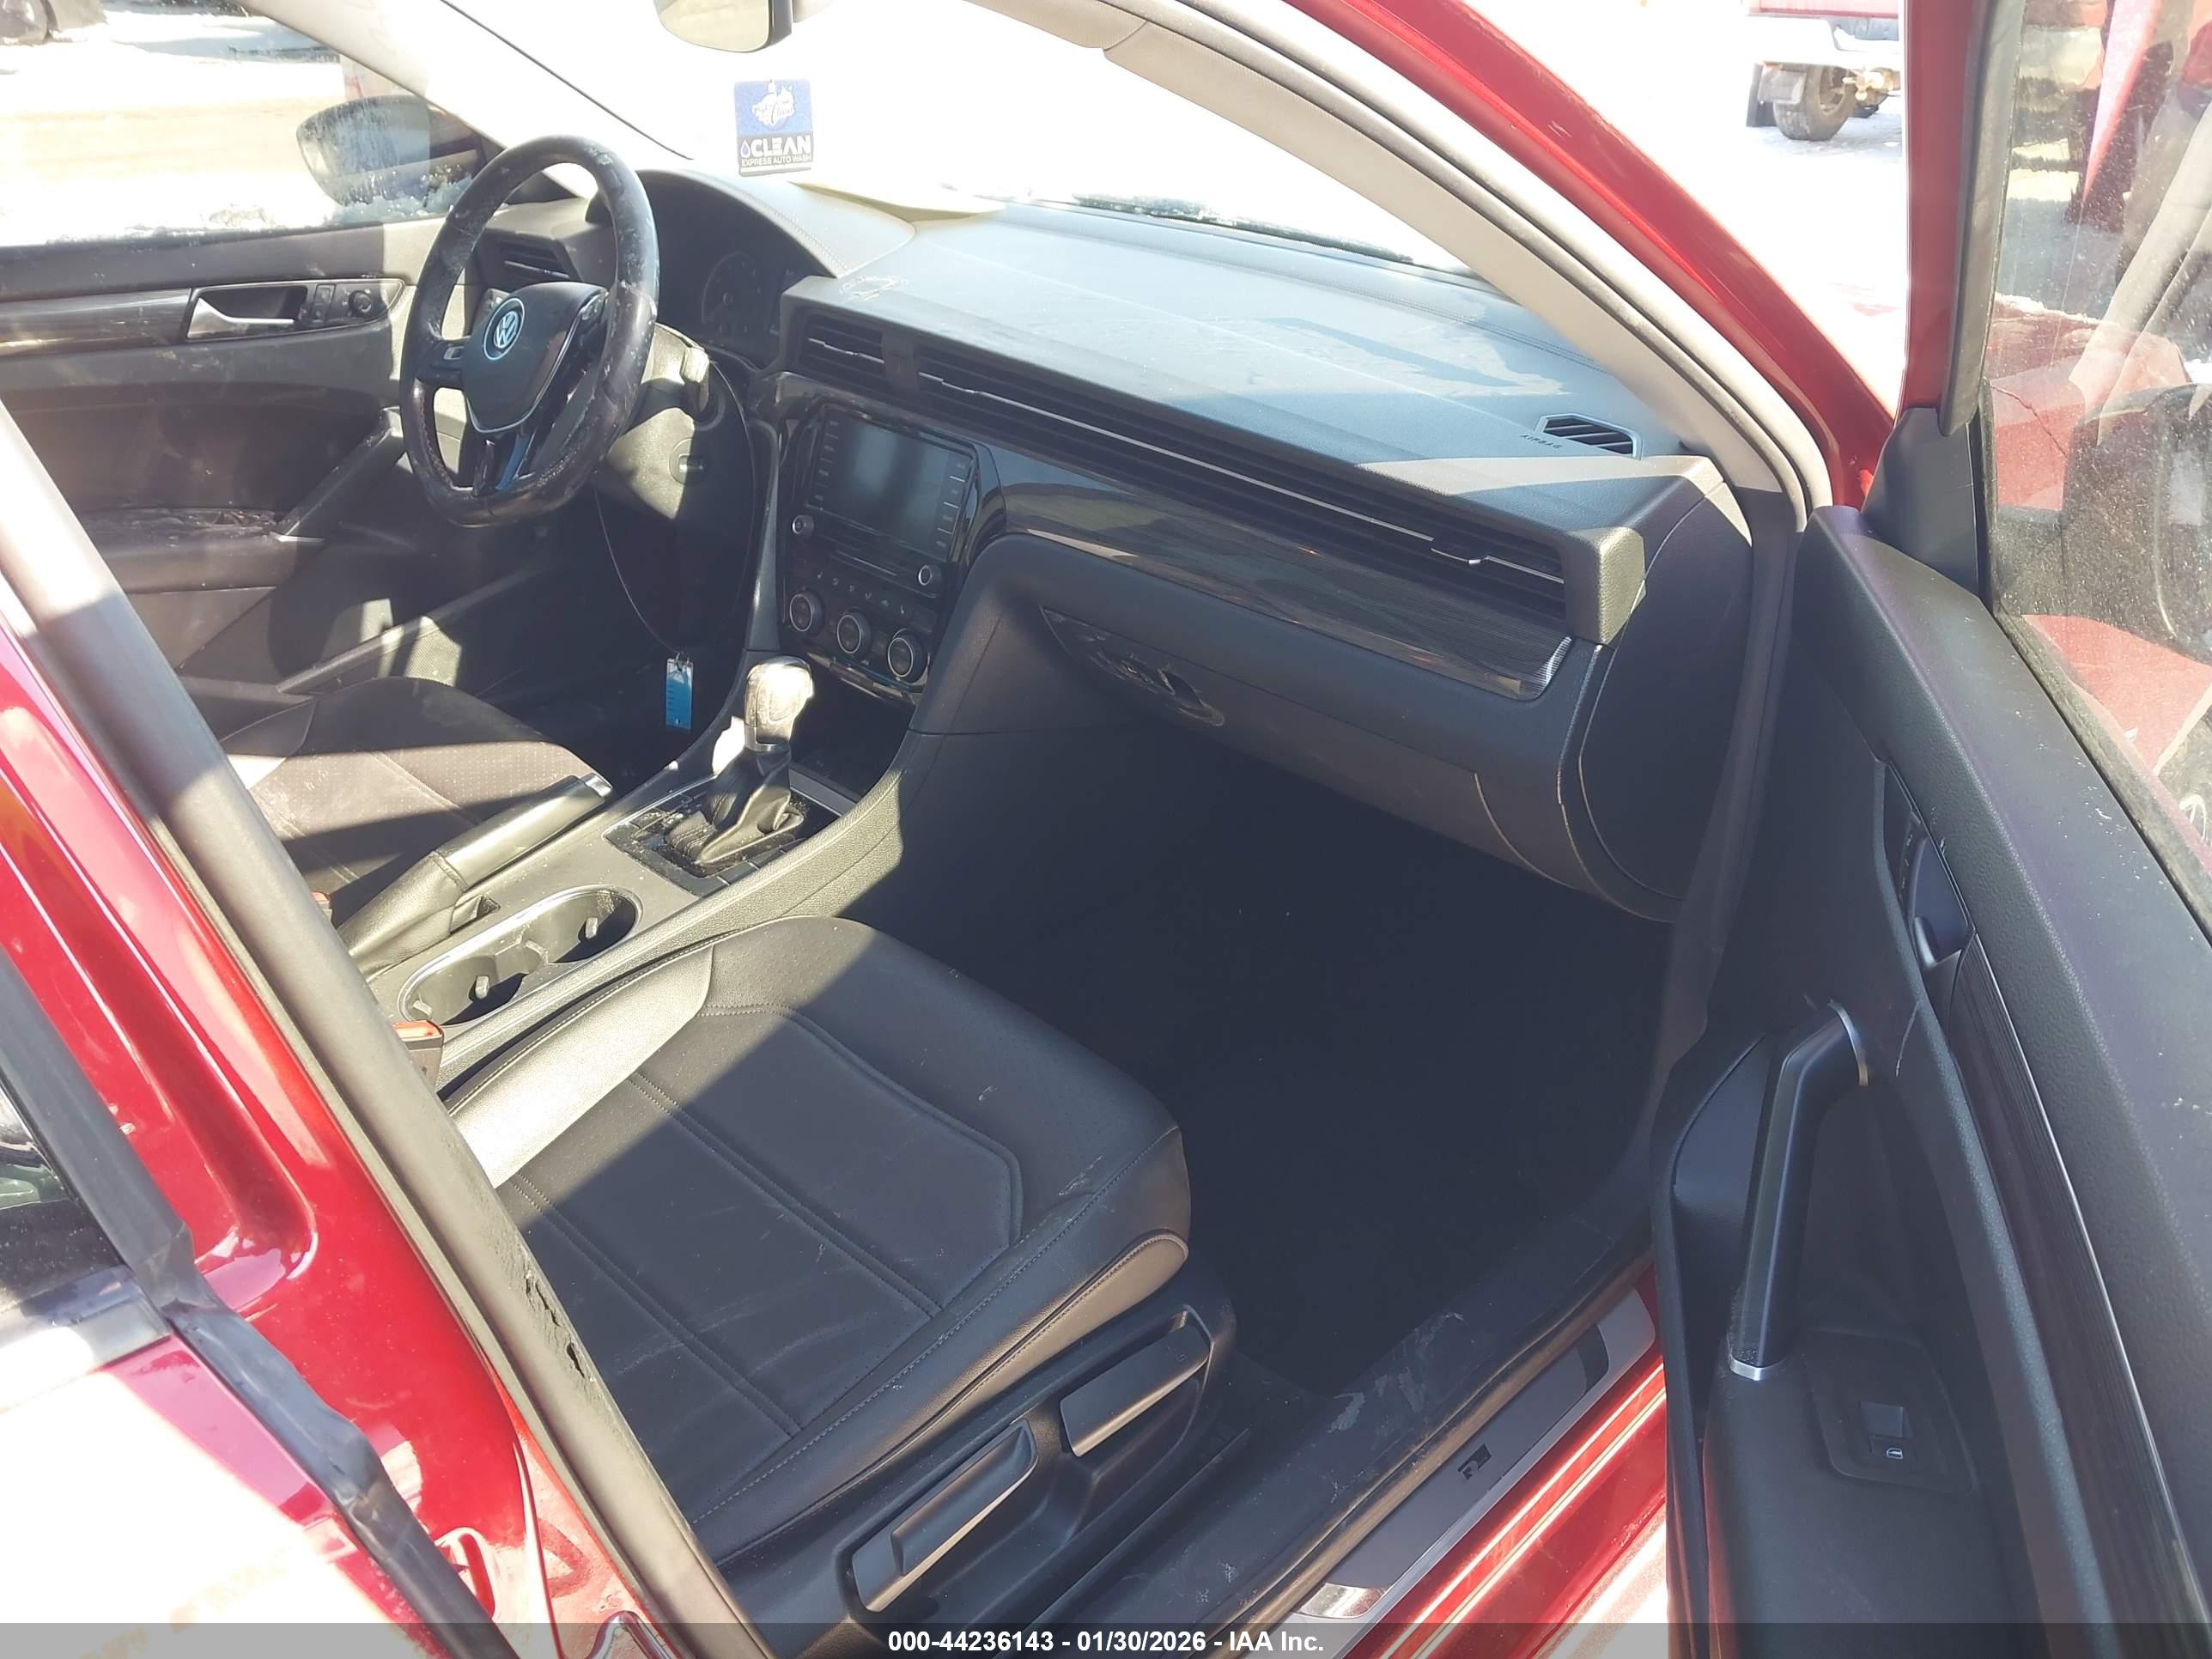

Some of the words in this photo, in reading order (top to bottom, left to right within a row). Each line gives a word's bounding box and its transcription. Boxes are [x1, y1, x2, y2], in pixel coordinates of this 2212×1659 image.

[750, 136, 811, 158] CLEAN
[773, 155, 792, 166] AUTO
[792, 154, 812, 163] WASH
[1521, 434, 1562, 449] AIRBAG
